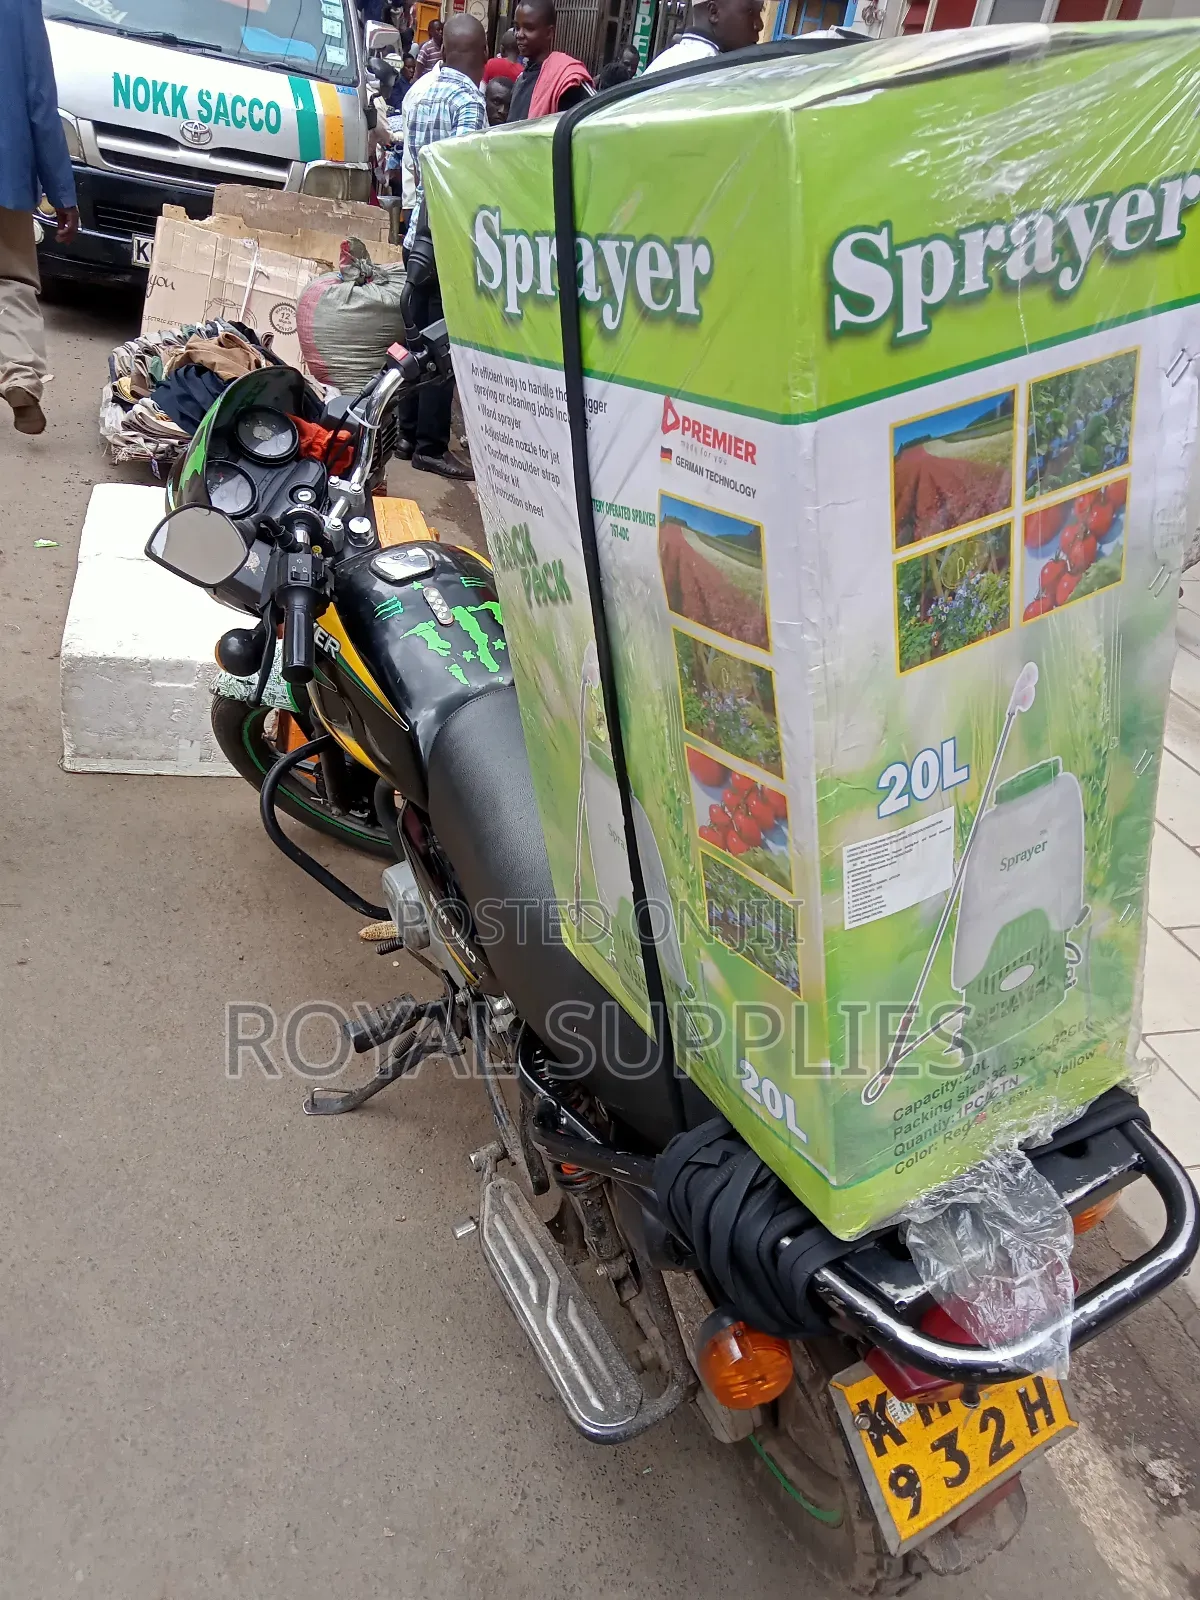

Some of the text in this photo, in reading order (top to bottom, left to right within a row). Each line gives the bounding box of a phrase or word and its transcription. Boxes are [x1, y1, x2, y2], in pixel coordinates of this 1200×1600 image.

[112, 72, 282, 135] NOKK SACCO
[473, 206, 712, 333] Sprayer
[830, 176, 1200, 340] Sprayer
[472, 363, 479, 376] An
[480, 366, 503, 386] efficient
[504, 375, 518, 392] way
[519, 378, 527, 391] to
[528, 379, 554, 398] handle
[474, 384, 498, 403] spraying
[498, 390, 505, 403] or
[506, 394, 536, 416] cleaning
[537, 402, 554, 418] jobs
[498, 413, 521, 430] sprayer
[681, 415, 757, 465] PREMIER
[484, 425, 561, 465] Adjustable nozzle for jet
[510, 457, 540, 477] shoulder
[542, 469, 560, 487] strap
[511, 474, 520, 488] kit
[675, 456, 757, 500] GERMAN TECHNOLOGY
[525, 499, 544, 517] sheet
[605, 501, 631, 521] OPERATED
[632, 508, 656, 528] SPRAYER
[876, 737, 970, 819] 20L
[1000, 840, 1048, 872] Sprayer
[739, 1057, 809, 1145] 20L
[893, 1101, 952, 1140] Packing
[894, 1140, 938, 1175] Color:
[888, 1376, 1056, 1521] 932H
